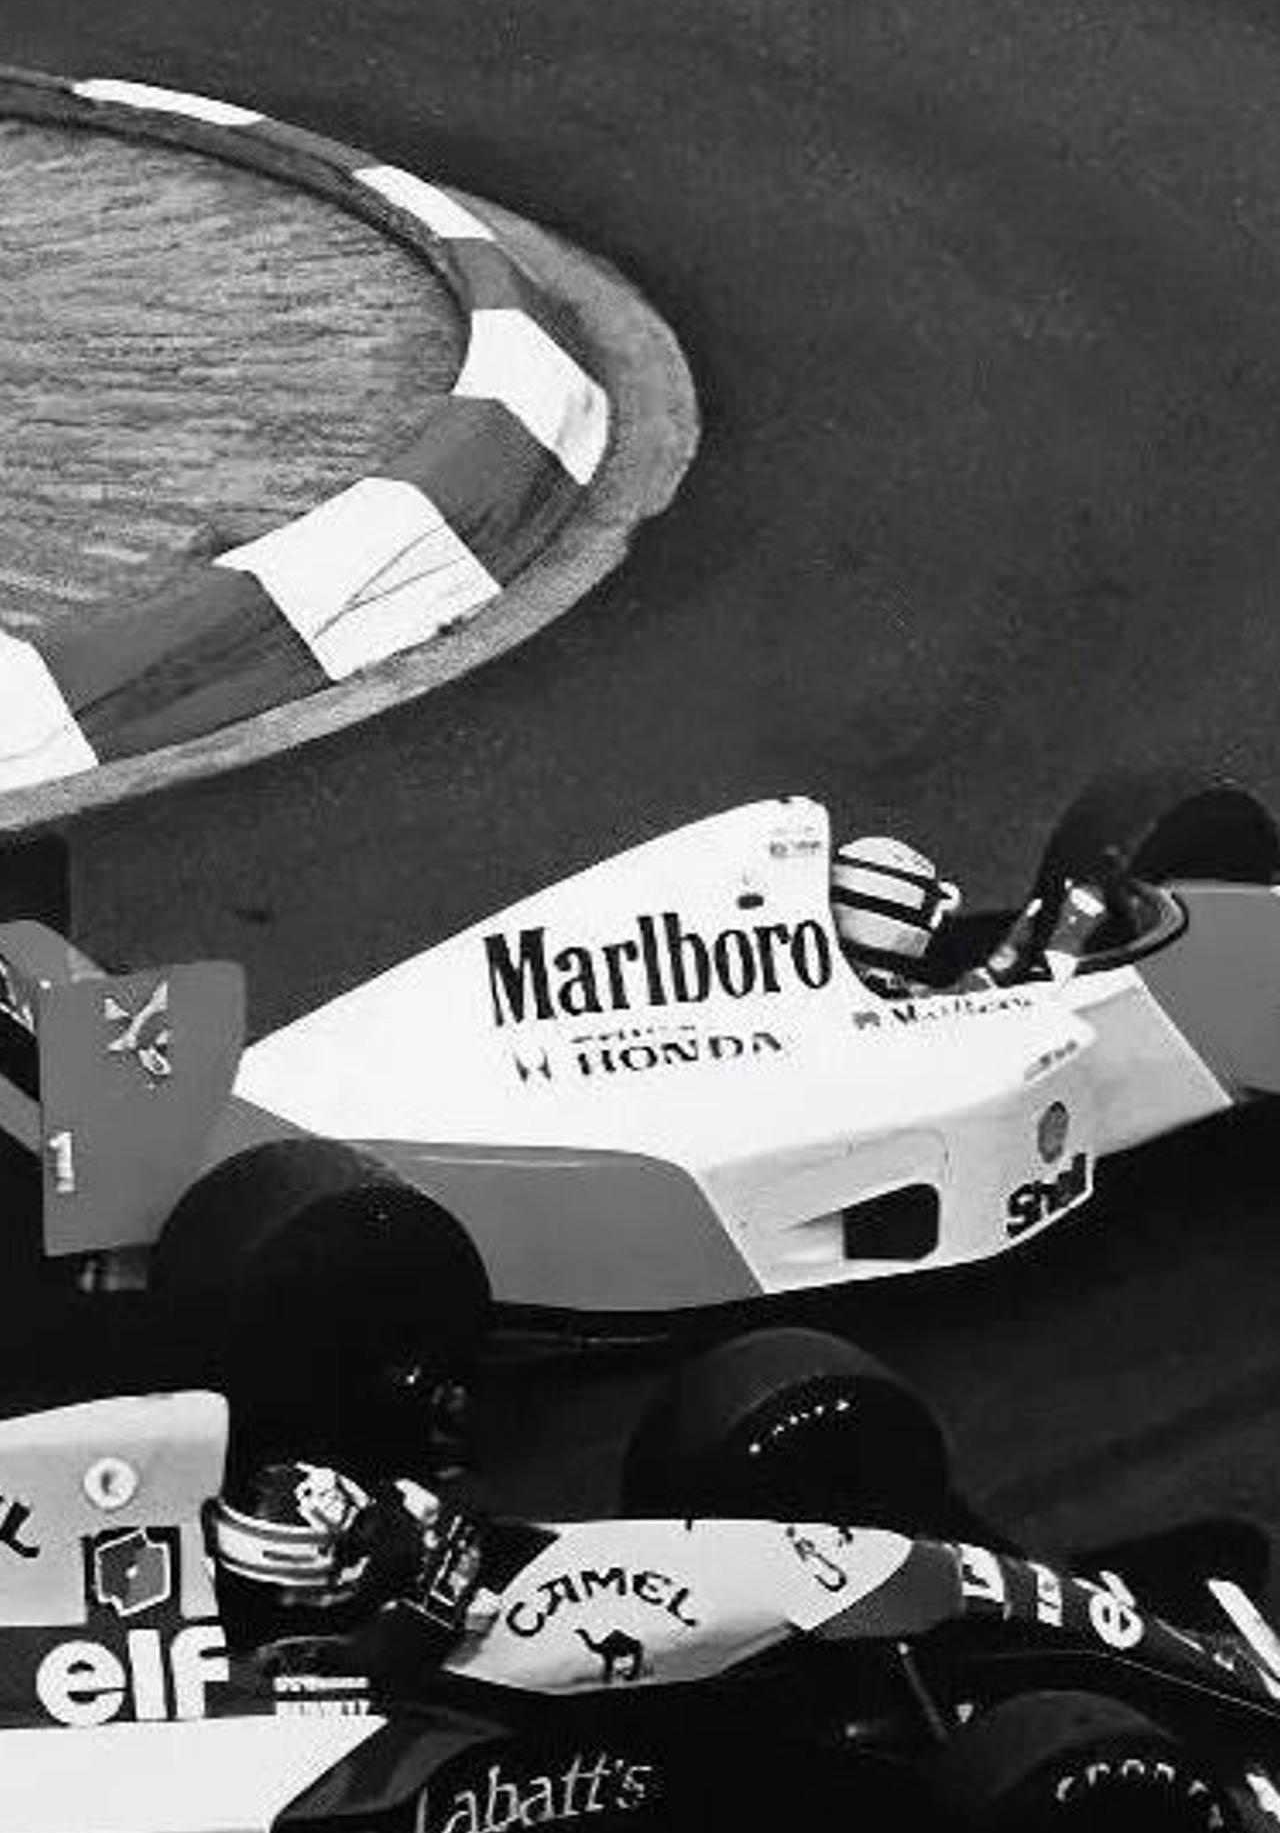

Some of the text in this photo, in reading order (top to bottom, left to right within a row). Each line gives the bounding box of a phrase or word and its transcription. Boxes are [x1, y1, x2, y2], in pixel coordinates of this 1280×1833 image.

[484, 913, 831, 1026] Marlboro
[50, 1132, 74, 1192] 1
[506, 1568, 697, 1637] CAMEL
[36, 1616, 228, 1726] elf
